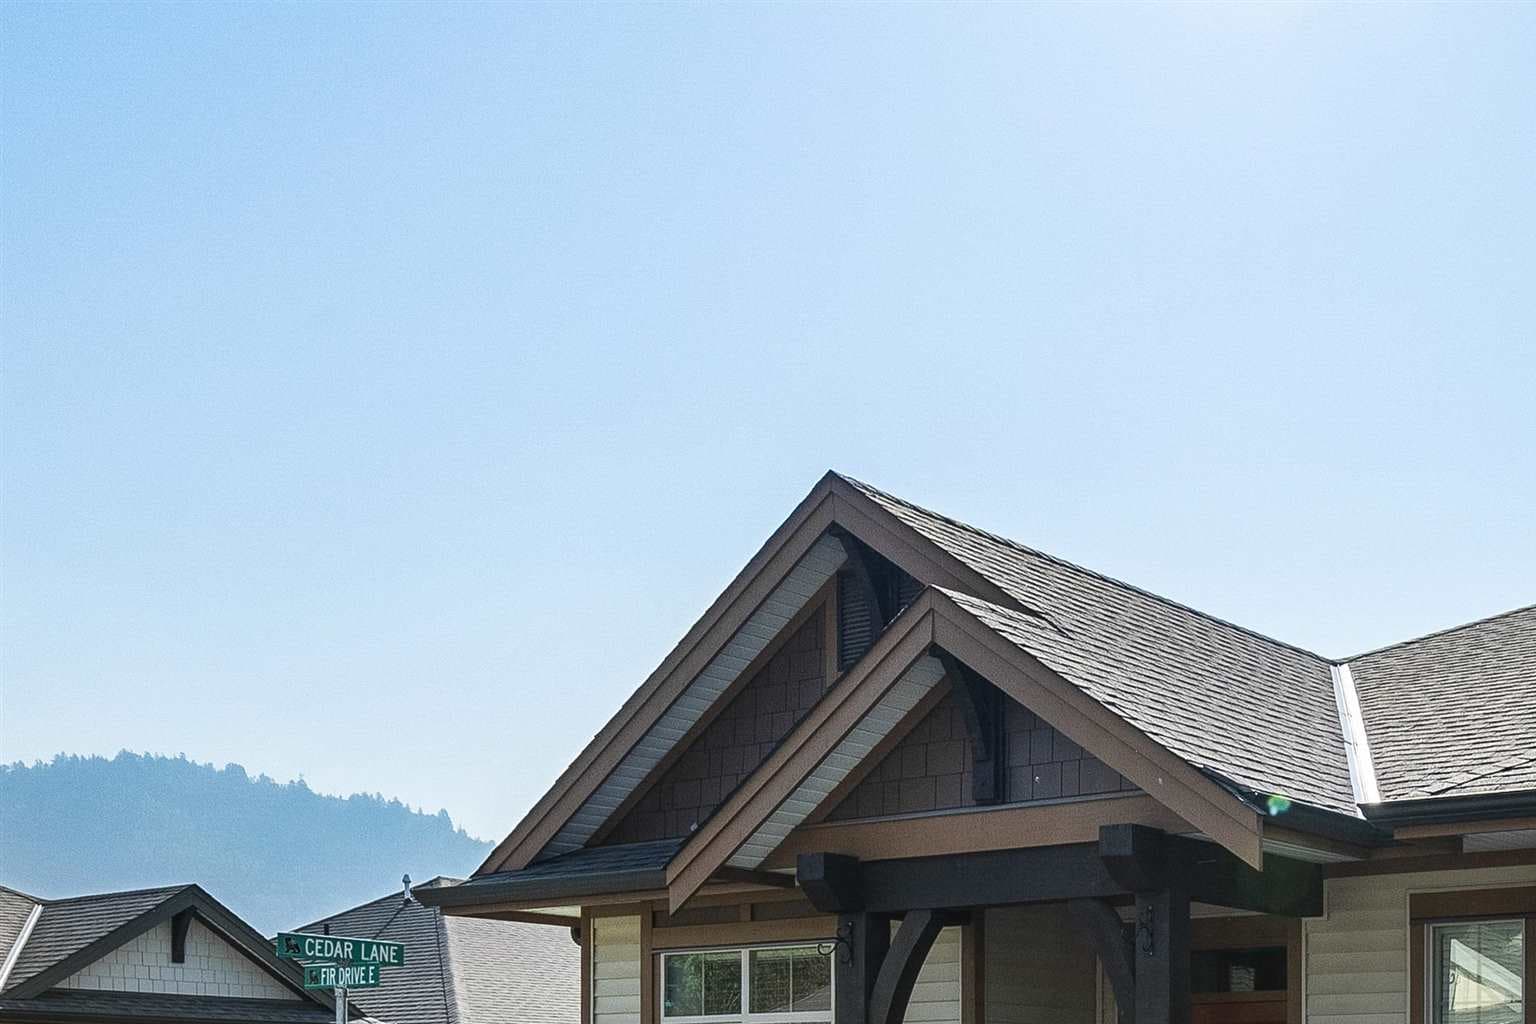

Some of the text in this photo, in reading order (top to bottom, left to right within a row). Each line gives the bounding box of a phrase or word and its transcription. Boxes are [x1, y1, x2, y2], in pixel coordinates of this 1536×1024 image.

[305, 938, 398, 963] CEDAR LANE
[321, 966, 375, 986] FIR DRIVE E
